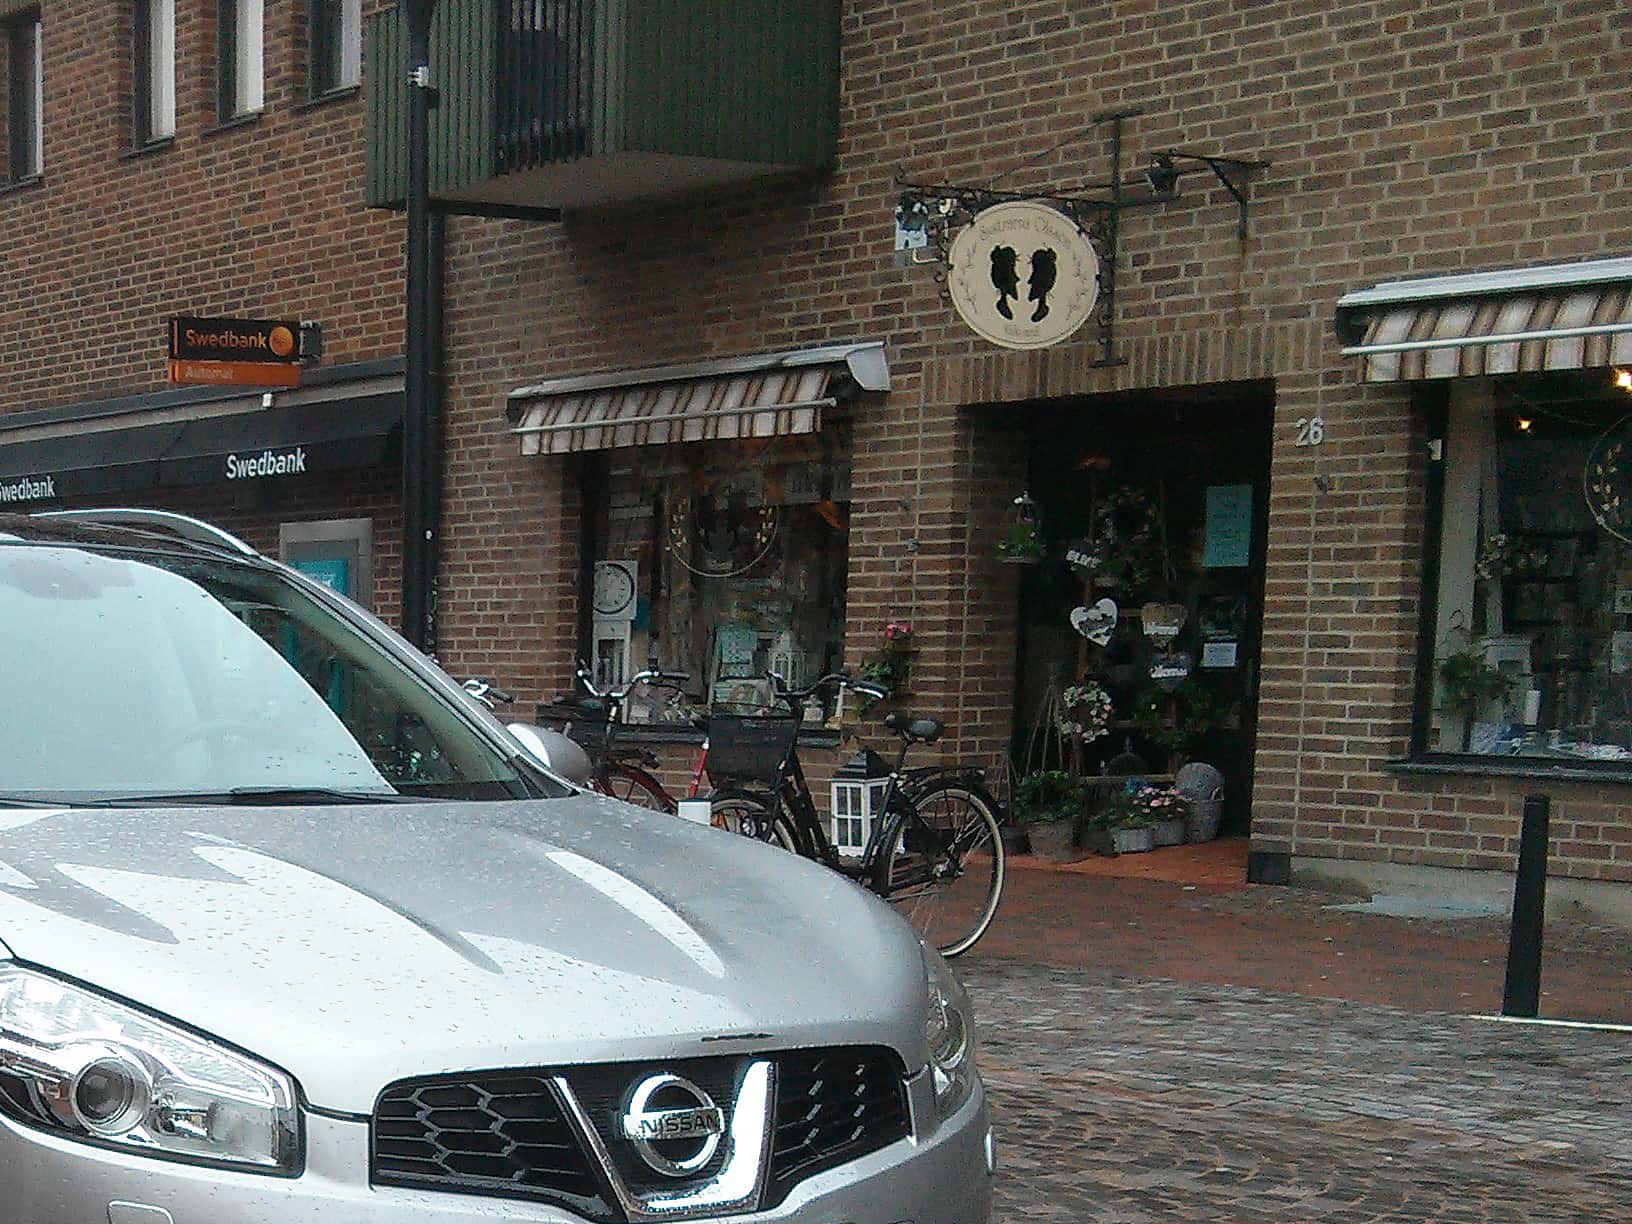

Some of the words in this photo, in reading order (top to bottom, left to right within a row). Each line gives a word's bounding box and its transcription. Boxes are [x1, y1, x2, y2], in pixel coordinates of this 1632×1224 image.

[185, 329, 267, 349] Swedbank
[185, 366, 234, 379] Automat
[1295, 416, 1323, 447] 26
[225, 447, 306, 479] Swedbank
[639, 1114, 717, 1133] NISSAN
